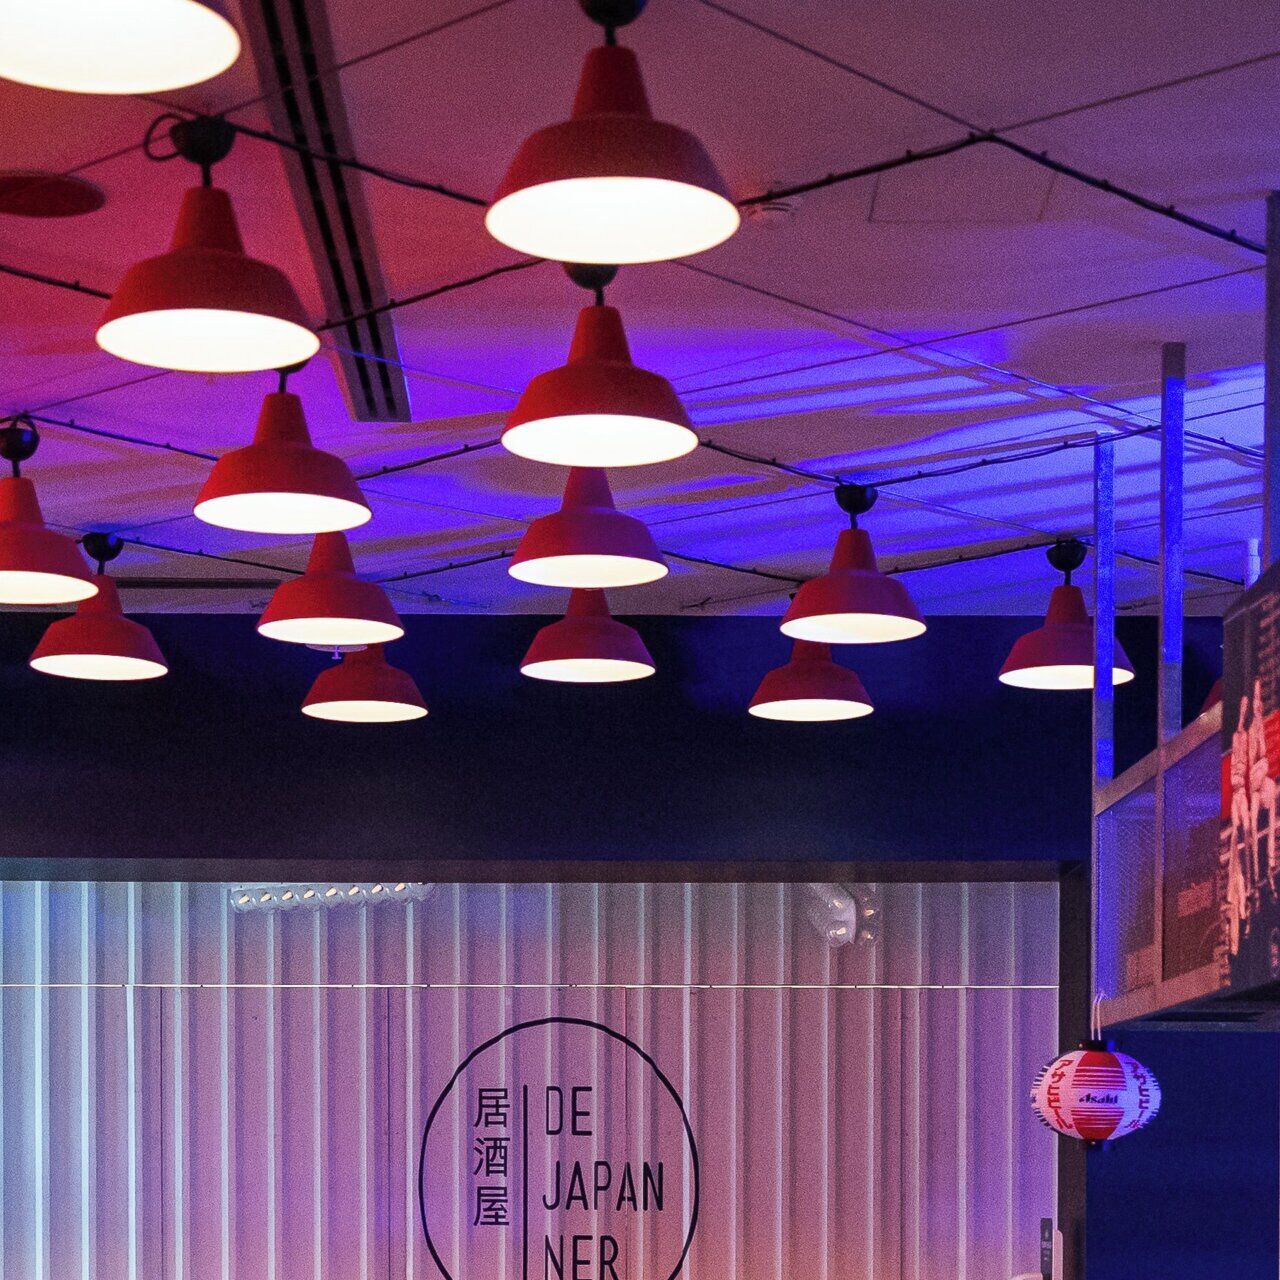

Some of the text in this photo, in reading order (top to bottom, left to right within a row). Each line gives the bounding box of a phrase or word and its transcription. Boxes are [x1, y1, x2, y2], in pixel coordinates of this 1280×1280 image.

[545, 1086, 592, 1136] DE
[1078, 1093, 1118, 1104] Asahi
[473, 1087, 510, 1227] 居酒屋
[542, 1161, 663, 1211] JAPAN
